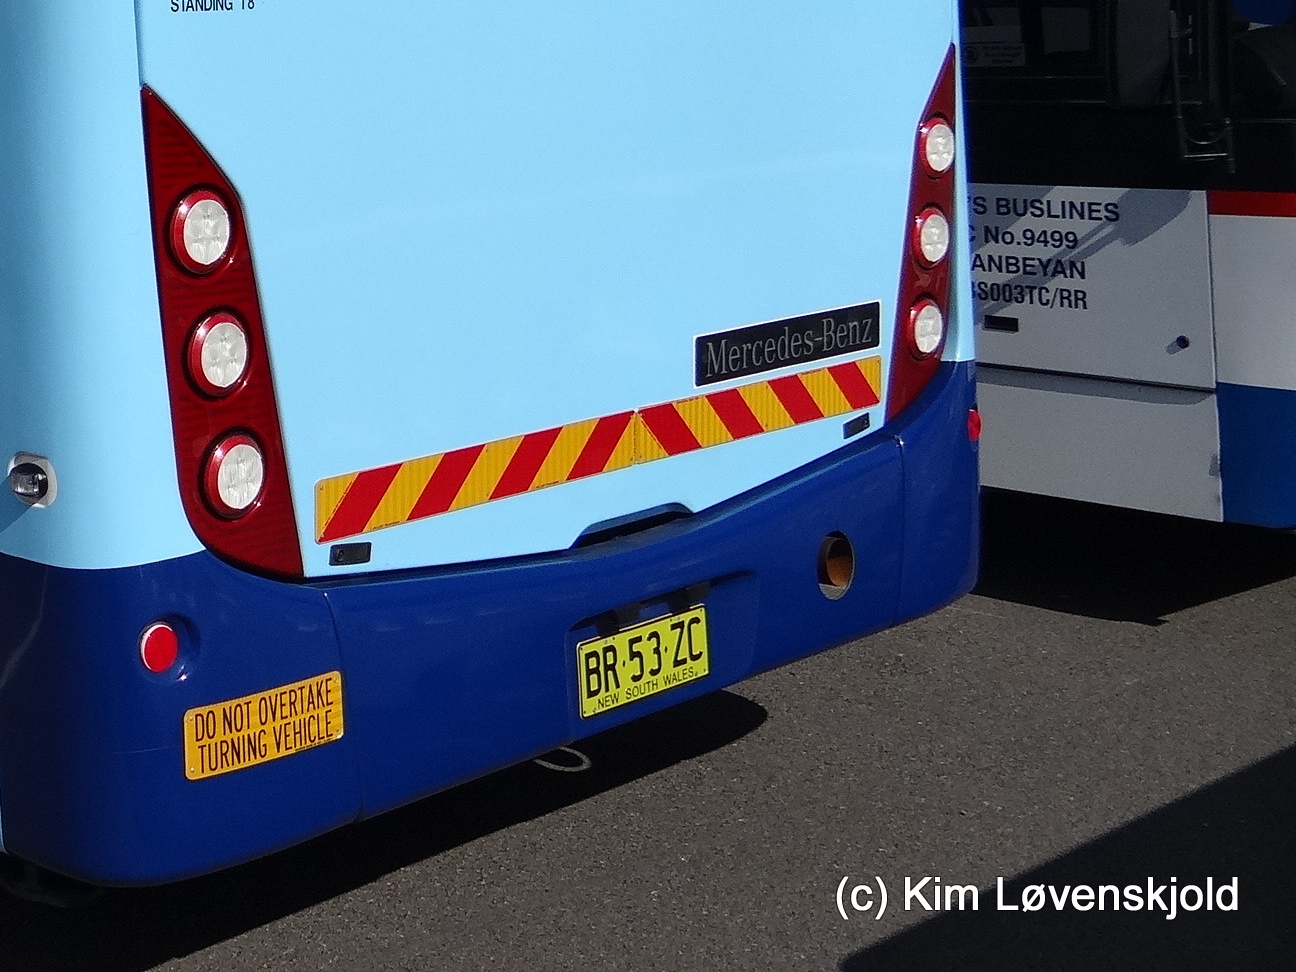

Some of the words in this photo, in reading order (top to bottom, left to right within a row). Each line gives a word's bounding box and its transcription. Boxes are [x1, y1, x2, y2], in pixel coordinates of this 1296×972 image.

[995, 197, 1120, 222] BUSLINES
[984, 225, 1078, 249] No.9499
[971, 253, 1086, 279] ANBEYAN
[705, 317, 873, 378] Mercedes-Benz
[597, 692, 620, 709] NEW
[625, 679, 658, 700] SOUTH
[663, 666, 694, 687] WALES
[195, 710, 216, 742] DO
[222, 701, 252, 736] NOT
[258, 678, 333, 725] OVERTAKE
[198, 729, 267, 774] TURNING
[273, 709, 334, 753] VEHICLE
